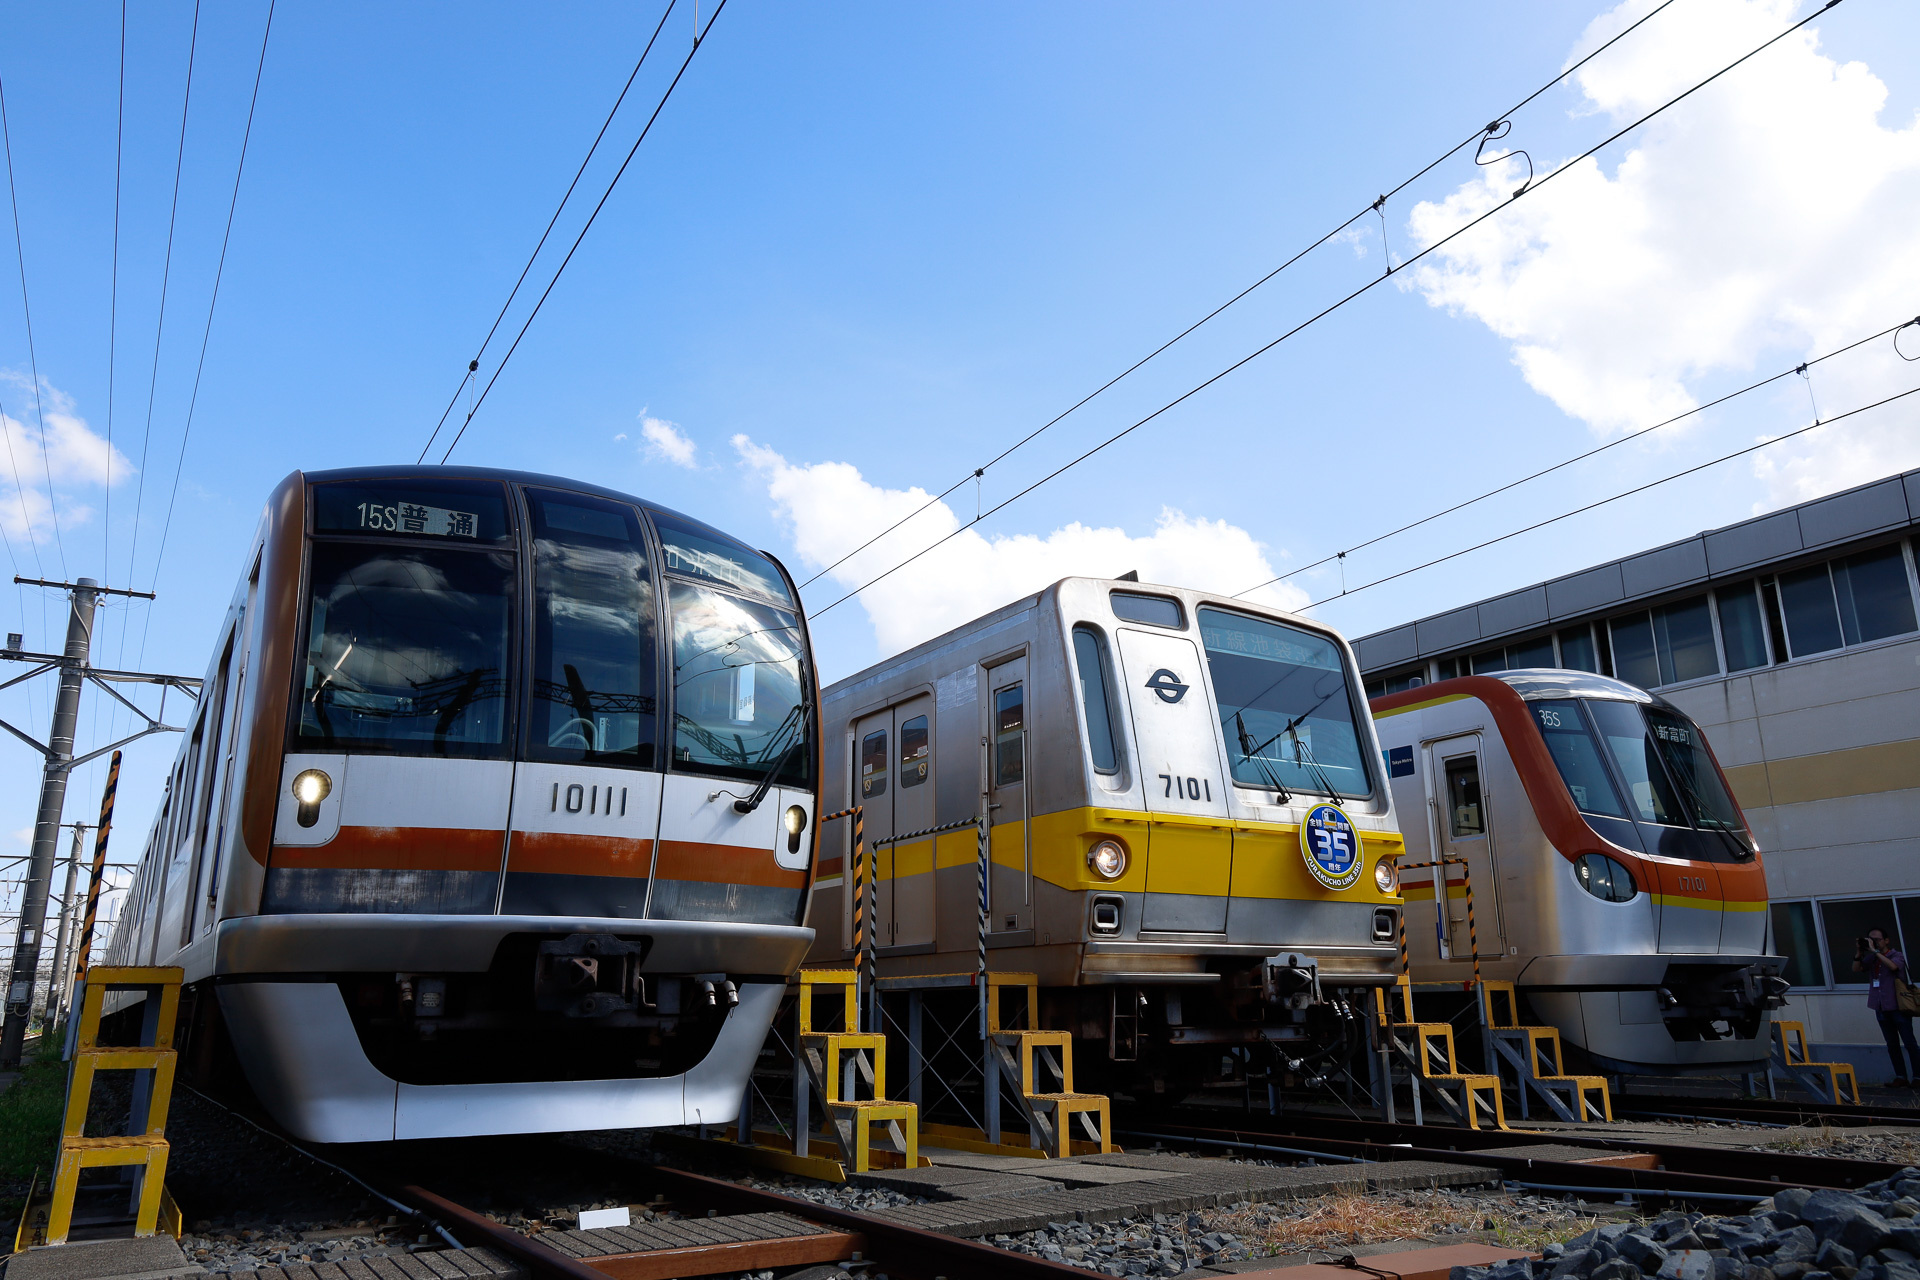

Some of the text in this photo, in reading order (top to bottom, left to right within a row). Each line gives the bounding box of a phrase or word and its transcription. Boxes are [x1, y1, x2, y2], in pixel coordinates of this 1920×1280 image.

[357, 502, 474, 536] 15S 普通
[1538, 709, 1561, 727] 35S
[551, 782, 628, 817] 10111
[1158, 773, 1212, 802] 7101
[1314, 828, 1351, 863] 35
[1307, 855, 1341, 886] YURAKUCHO
[1341, 873, 1355, 886] LINE
[1678, 876, 1707, 892] 17101
